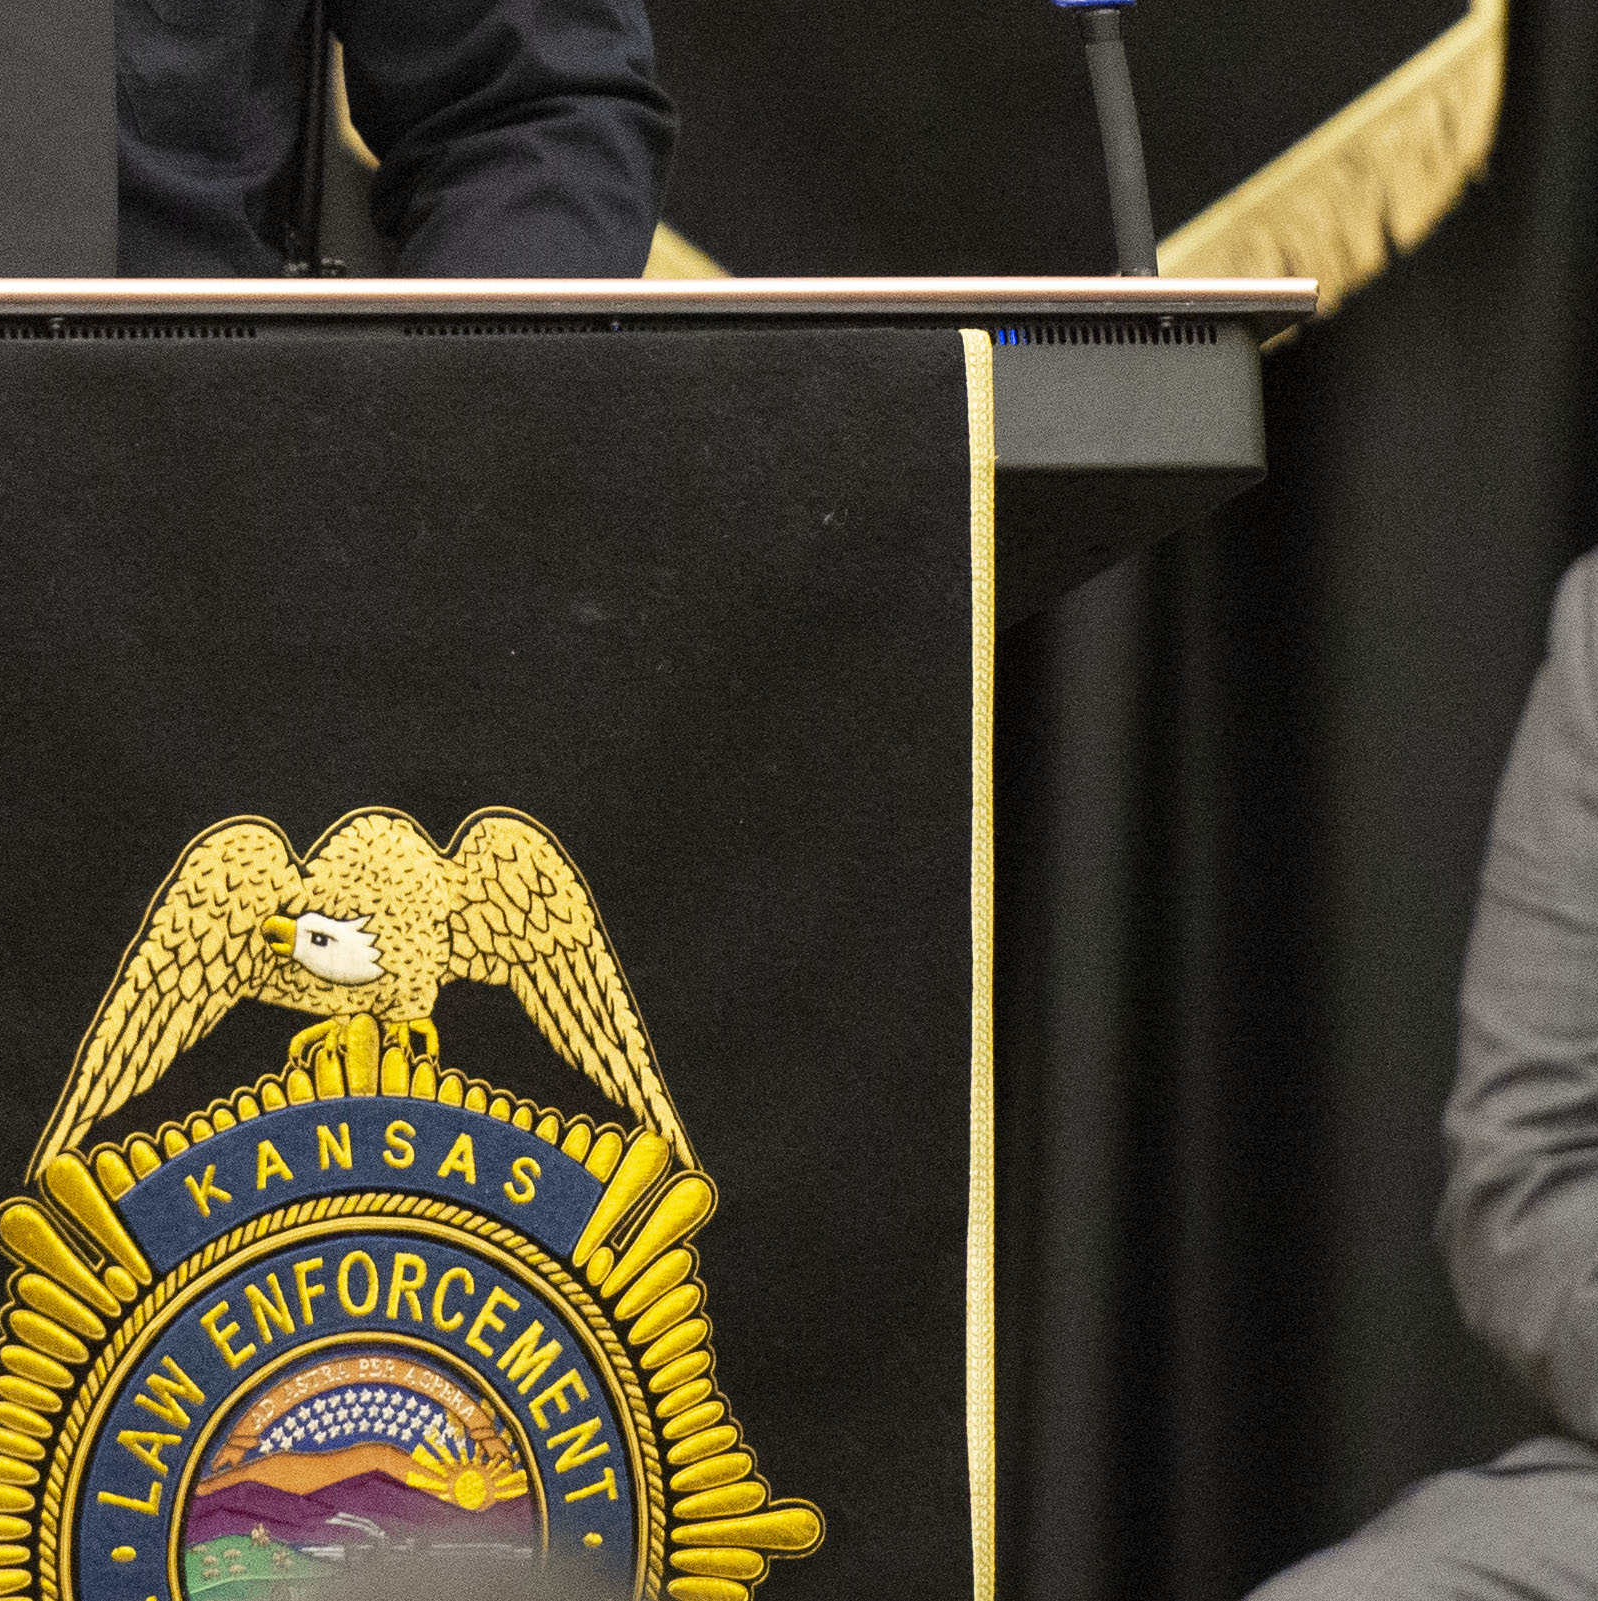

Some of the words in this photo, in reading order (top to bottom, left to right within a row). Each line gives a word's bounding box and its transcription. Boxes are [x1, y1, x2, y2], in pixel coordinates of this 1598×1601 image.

[184, 1119, 541, 1217] KANSAS
[98, 1355, 206, 1515] LAW
[200, 1250, 618, 1502] ENFORCEMENT
[251, 1398, 275, 1430] AD
[358, 1358, 395, 1378] PER
